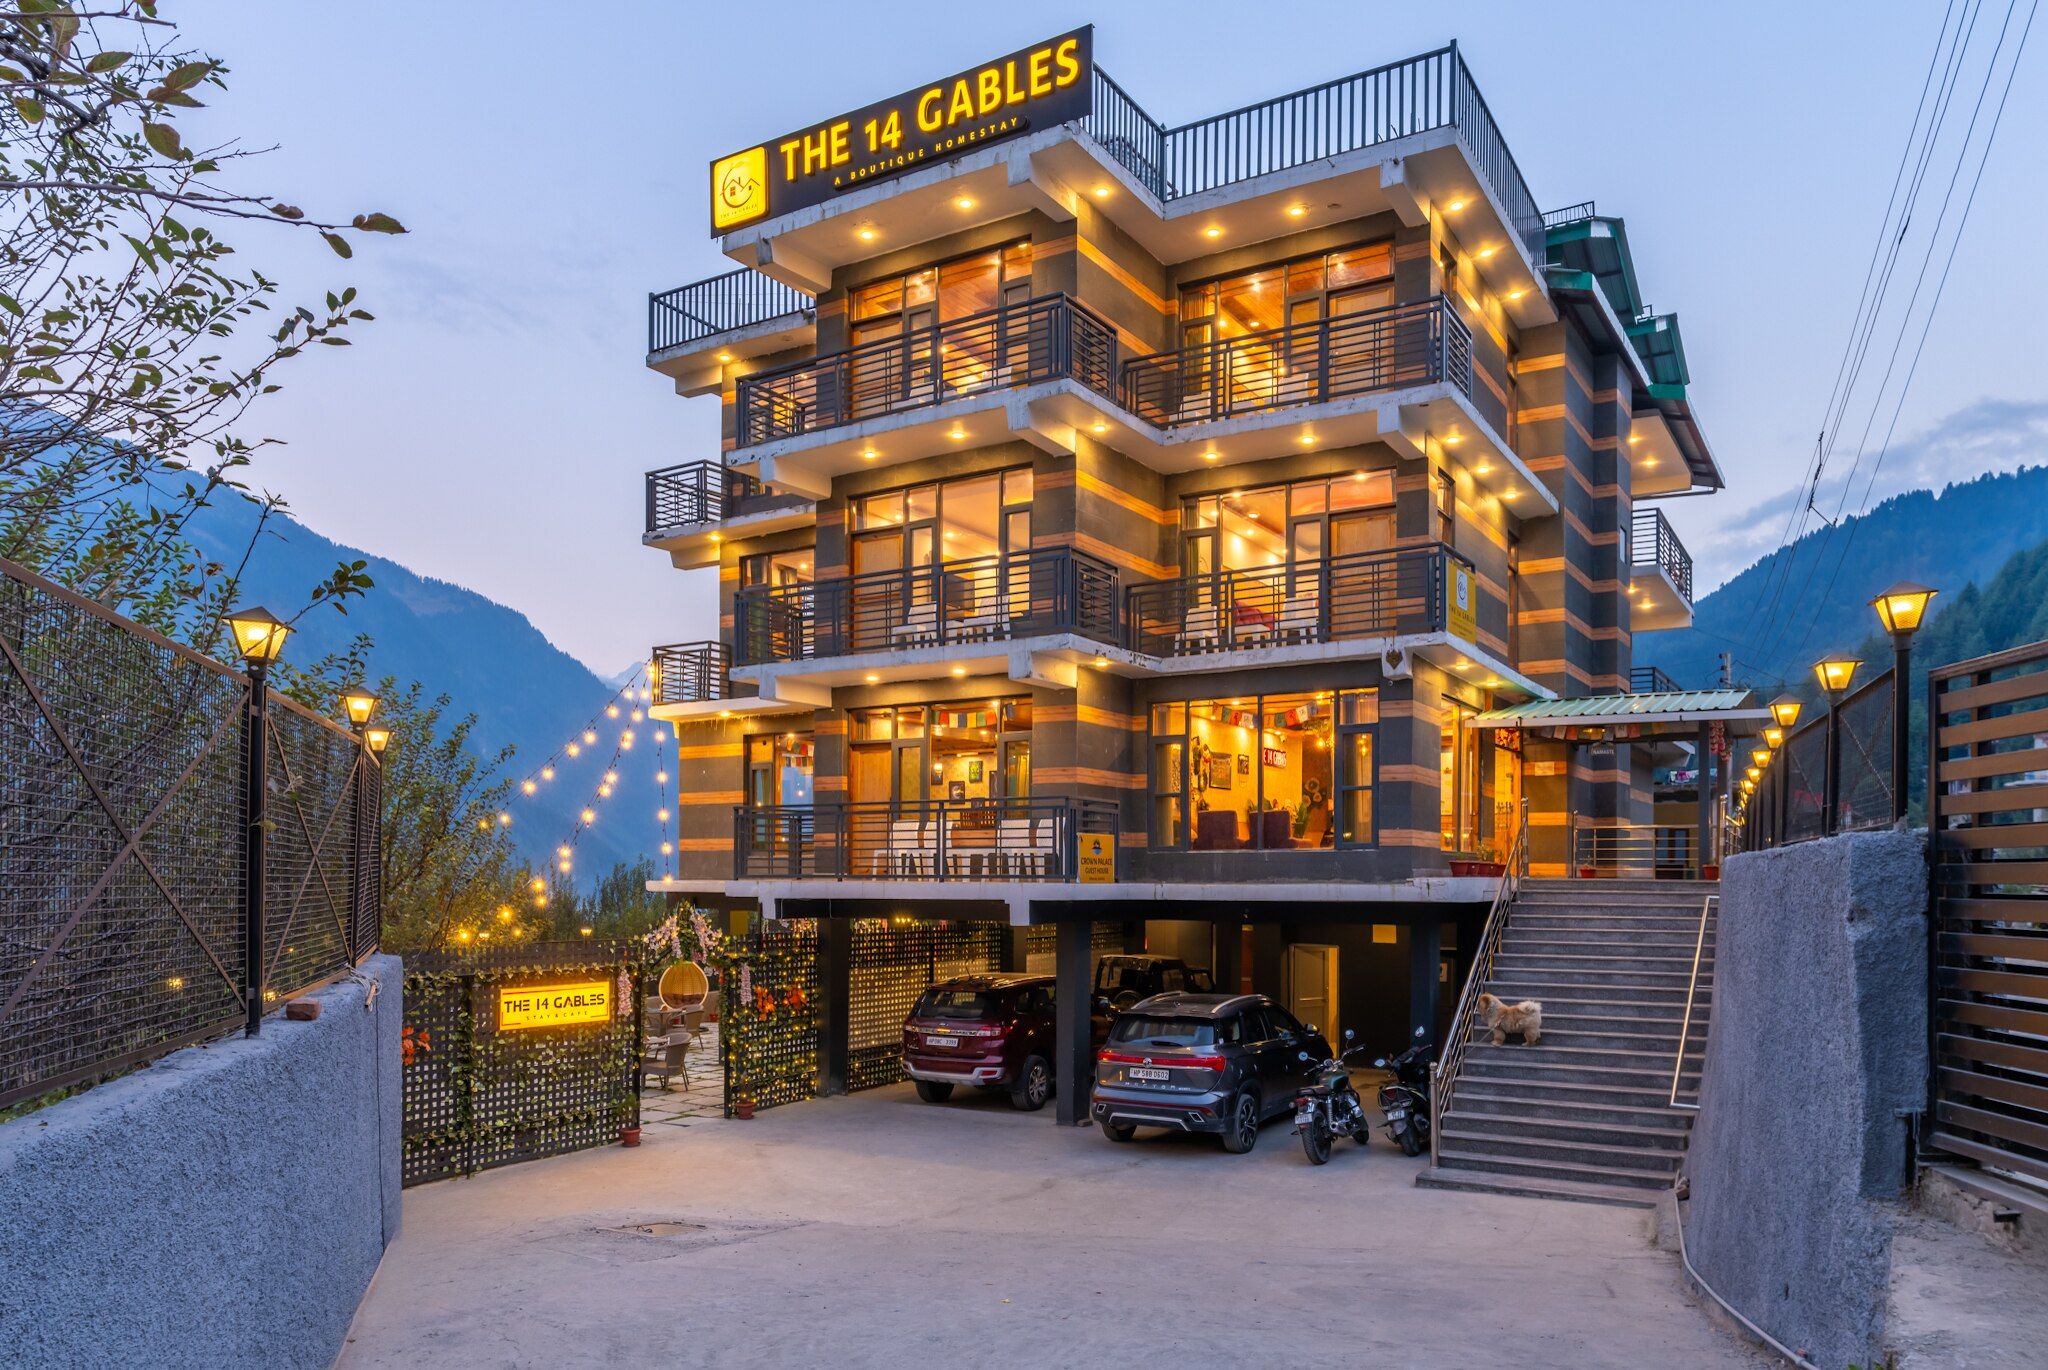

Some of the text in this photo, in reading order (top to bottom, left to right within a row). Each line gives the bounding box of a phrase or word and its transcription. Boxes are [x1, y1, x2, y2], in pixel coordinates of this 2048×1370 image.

[780, 37, 1082, 182] THE 14 GABLES
[834, 117, 1018, 186] A BOUTIQUE HOMESTAY
[1081, 857, 1113, 866] CROWN PALACE
[1097, 867, 1109, 875] HOUSE
[504, 993, 605, 1013] THE 14 GABLES
[563, 1010, 588, 1018] CAFE
[1133, 1069, 1140, 1077] HP
